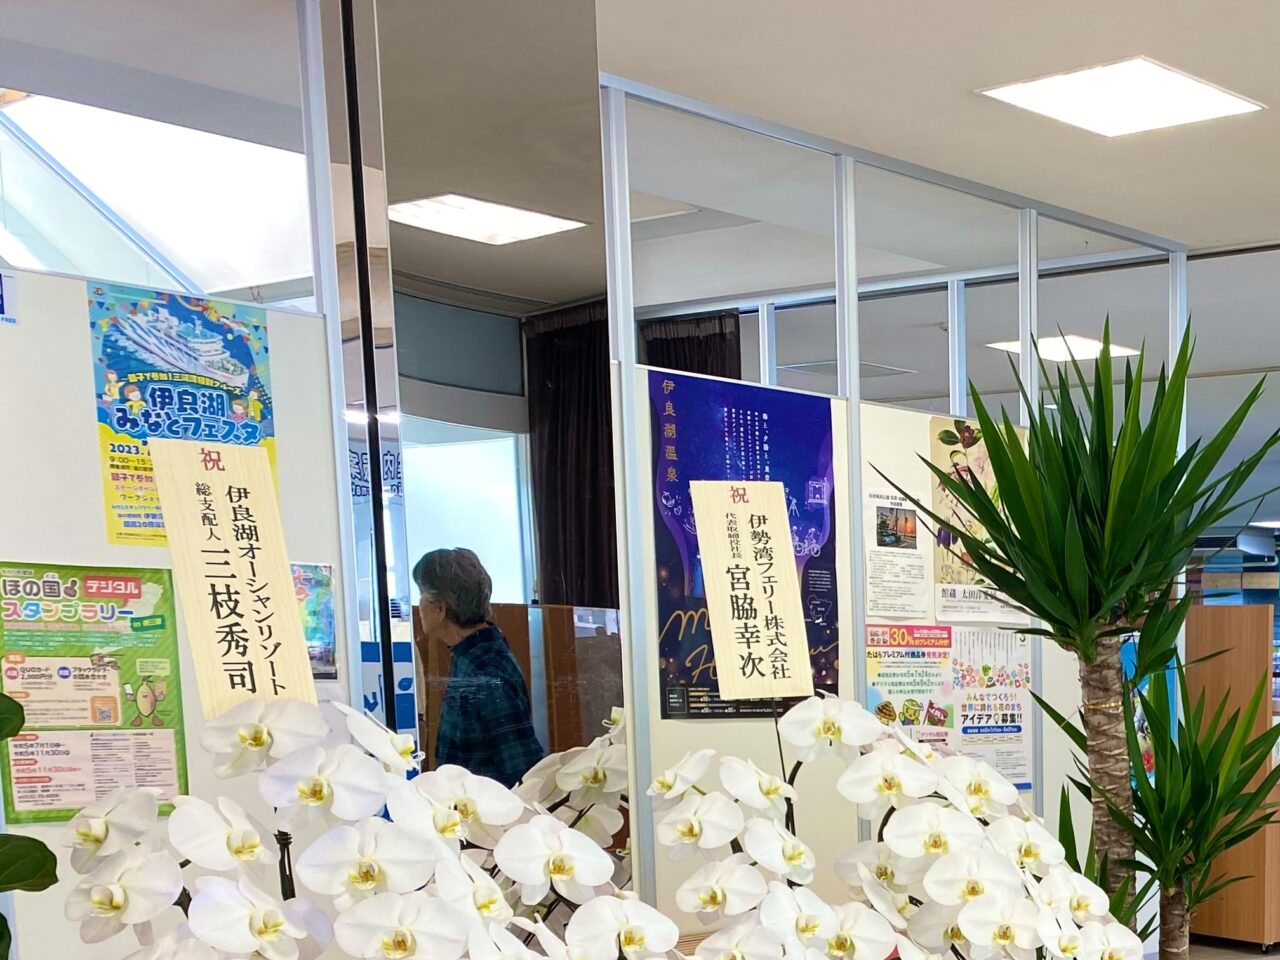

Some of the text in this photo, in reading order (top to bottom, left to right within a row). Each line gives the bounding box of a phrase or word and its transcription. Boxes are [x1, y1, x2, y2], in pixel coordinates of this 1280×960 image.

[149, 386, 226, 418] 伊良湖
[115, 407, 261, 442] みなとフェスタ
[109, 443, 150, 456] 2023.
[200, 447, 225, 471] 祝
[730, 485, 749, 504] 祝
[86, 580, 140, 594] デジタル
[195, 481, 257, 694] 総支配人 三枝秀司
[225, 485, 286, 695] 伊良湖オーシャンリゾート
[747, 513, 792, 680] 伊勢湾フェリー株式会社
[2, 601, 134, 621] スタンプラリー
[725, 563, 766, 679] 宮脇幸次
[961, 713, 992, 724] アイデア
